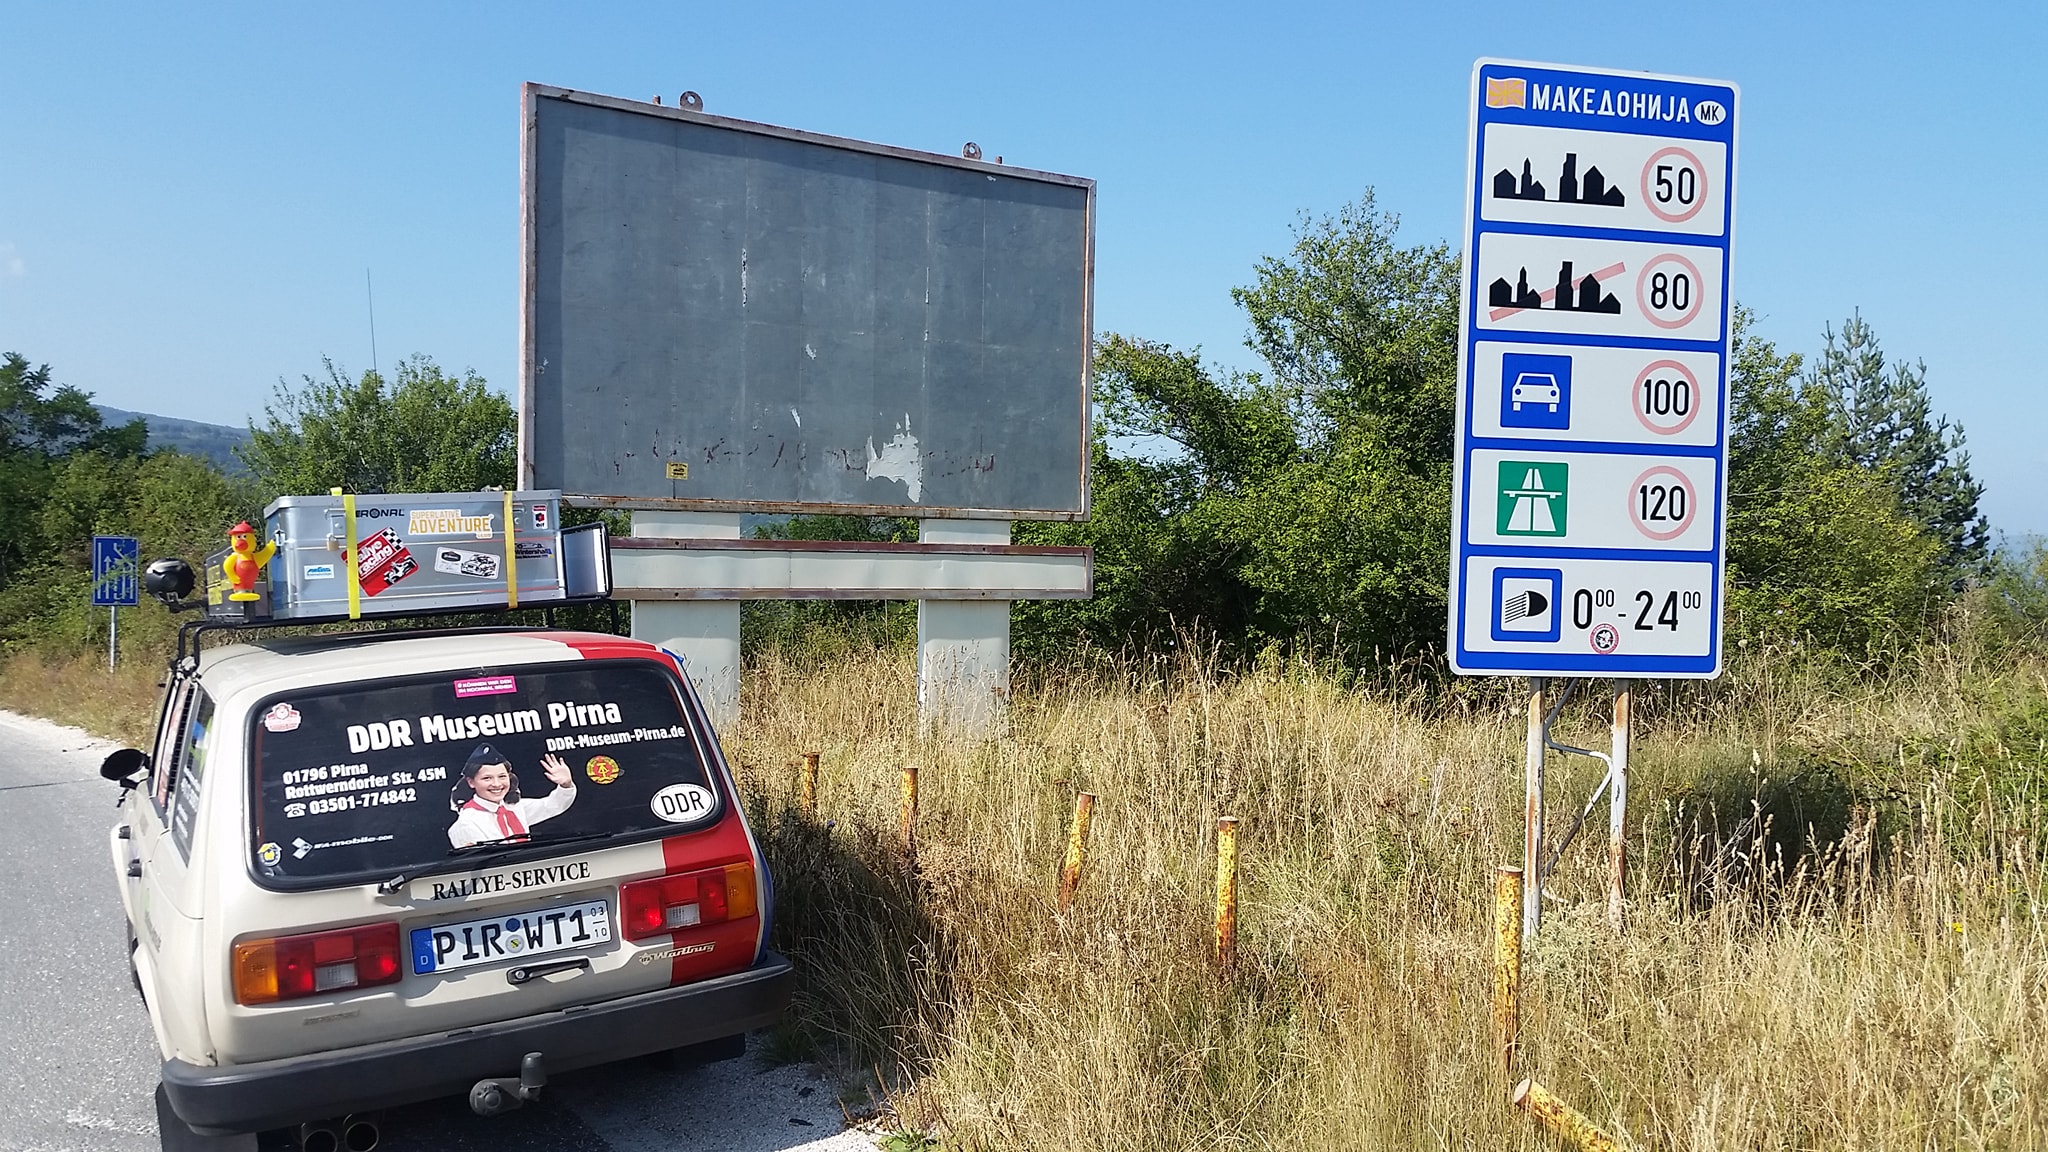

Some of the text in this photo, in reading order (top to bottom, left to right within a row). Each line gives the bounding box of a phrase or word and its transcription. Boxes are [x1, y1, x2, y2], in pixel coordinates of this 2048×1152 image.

[1532, 83, 1691, 124] МАКЕДОНИЈА
[1700, 104, 1720, 122] MK
[1655, 165, 1695, 205] 50
[1650, 272, 1690, 311] 80
[1643, 378, 1690, 417] 100
[411, 510, 460, 520] SUPERLATIVE
[1638, 484, 1686, 522] 120
[409, 517, 491, 534] ADVENTURE
[357, 540, 383, 564] allye
[358, 545, 393, 576] racing
[346, 701, 622, 754] DDR Museum Pirna
[545, 724, 686, 752] DDR-Museum-Pirna.de
[282, 763, 369, 785] 01796 Pirna
[285, 766, 447, 800] Rottwerndorfer Str. 45M
[309, 787, 417, 814] 03501-774842
[660, 790, 705, 816] DDR
[432, 861, 591, 901] RALLYE-SERVICE
[590, 906, 605, 917] 03
[433, 909, 591, 965] PIR WT1
[594, 927, 608, 938] 10
[420, 955, 429, 966] D
